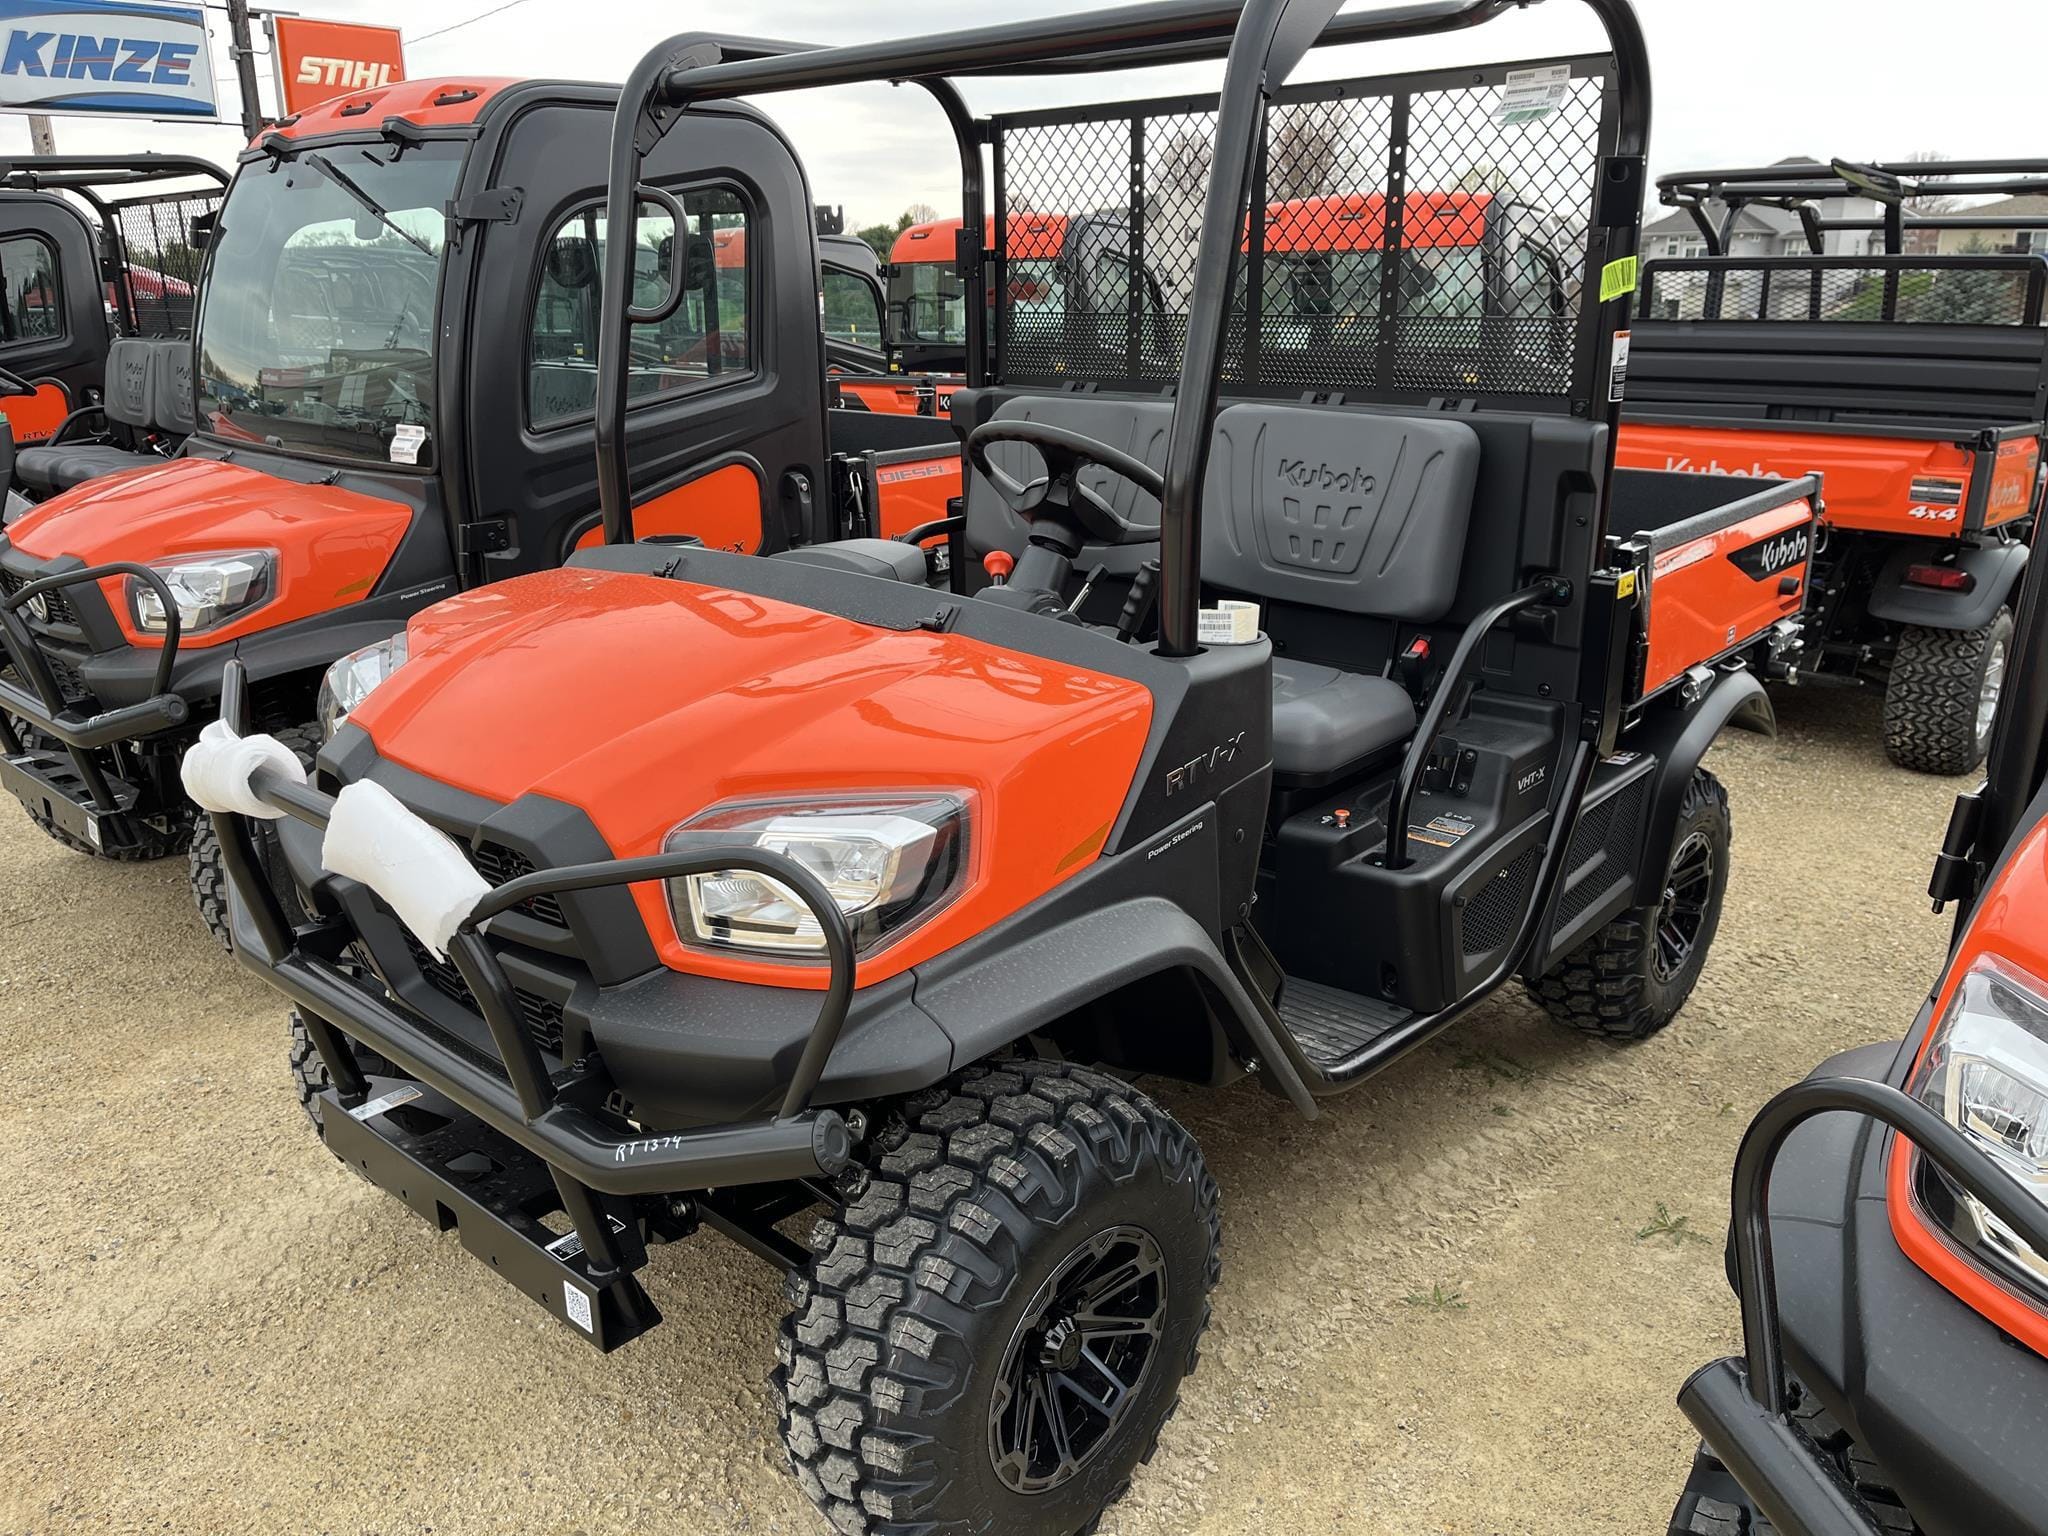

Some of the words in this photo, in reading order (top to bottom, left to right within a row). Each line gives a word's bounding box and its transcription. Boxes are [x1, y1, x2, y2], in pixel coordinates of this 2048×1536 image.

[1, 30, 199, 86] KINZE
[296, 56, 393, 89] STIHL
[1278, 459, 1377, 495] Kubota
[1908, 505, 1958, 521] 4x4
[1761, 530, 1808, 572] Kubota
[1166, 731, 1246, 797] RTV-X
[1517, 764, 1546, 791] VHT-X
[1147, 839, 1173, 860] Power
[1171, 821, 1204, 846] Steering
